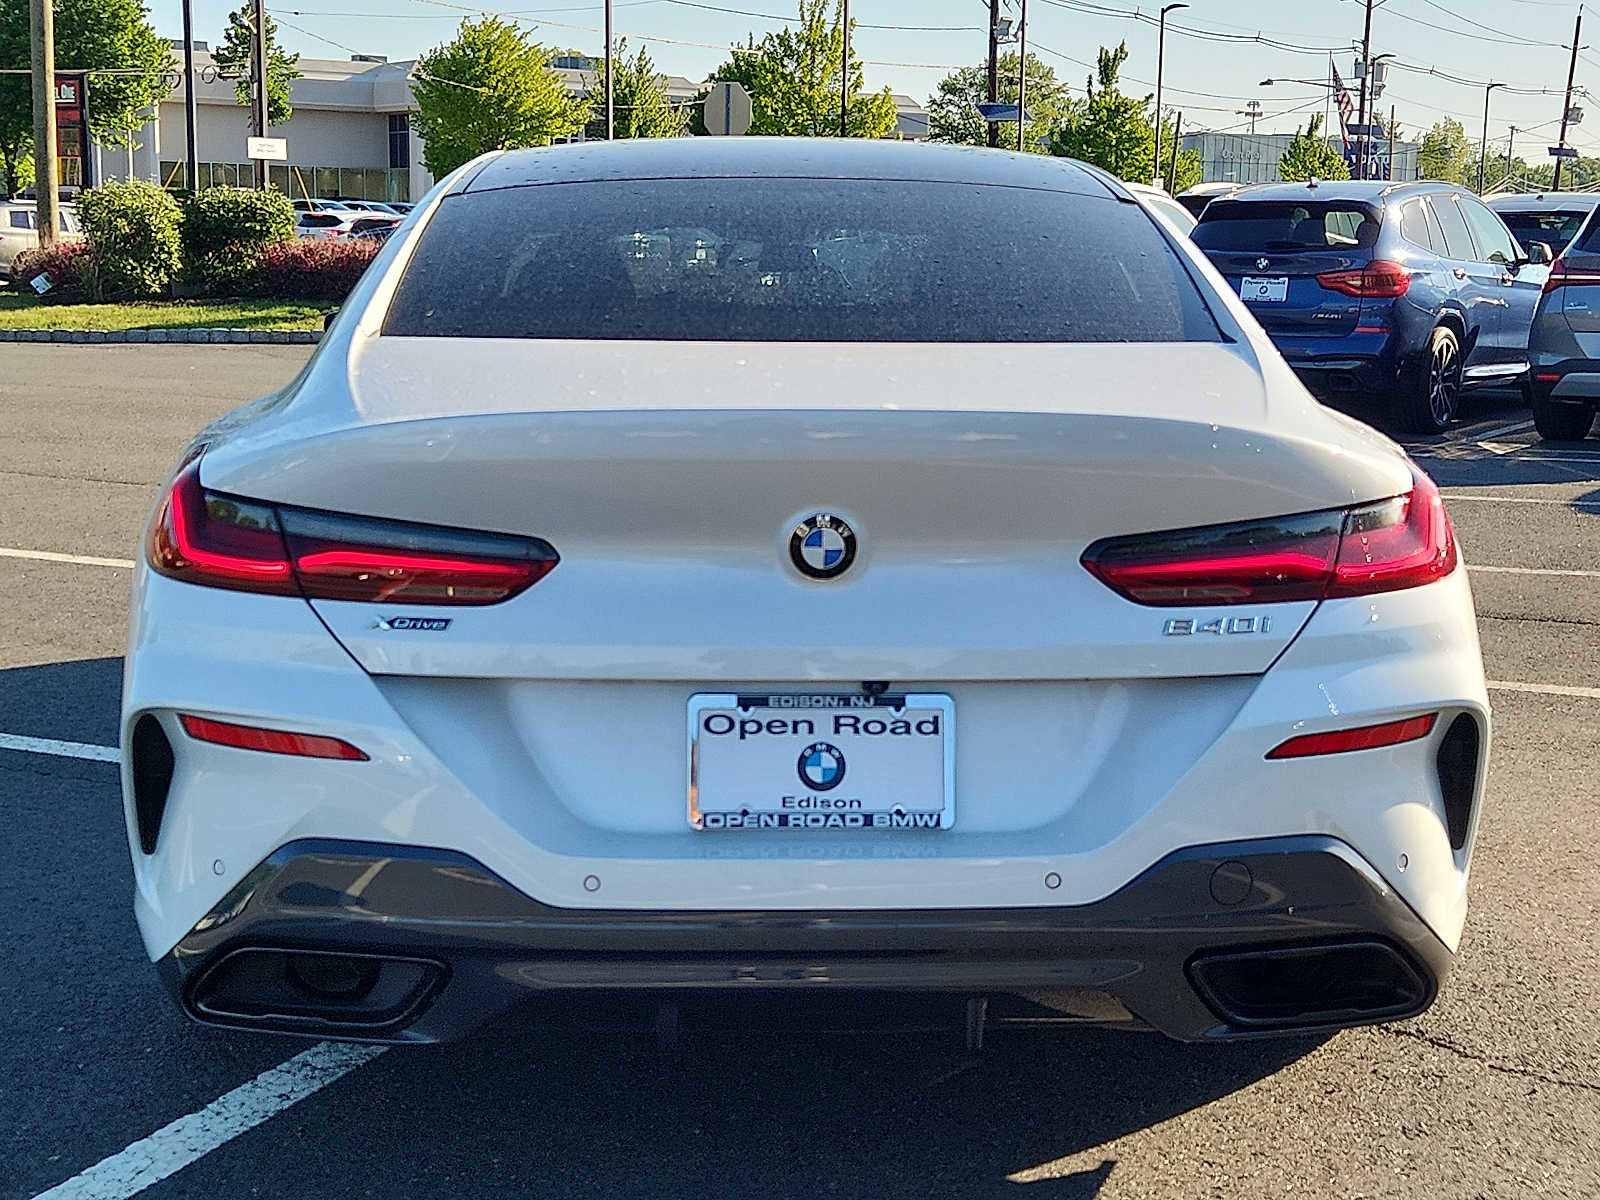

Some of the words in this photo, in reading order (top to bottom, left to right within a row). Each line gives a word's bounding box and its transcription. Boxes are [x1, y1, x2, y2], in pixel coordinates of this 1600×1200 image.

[1162, 616, 1272, 636] 840i
[849, 695, 874, 708] NJ
[704, 714, 814, 740] Open
[833, 715, 940, 735] Road
[782, 796, 862, 809] Edison
[705, 813, 780, 828] OPEN
[787, 813, 865, 828] ROAD
[872, 813, 938, 828] BMW
